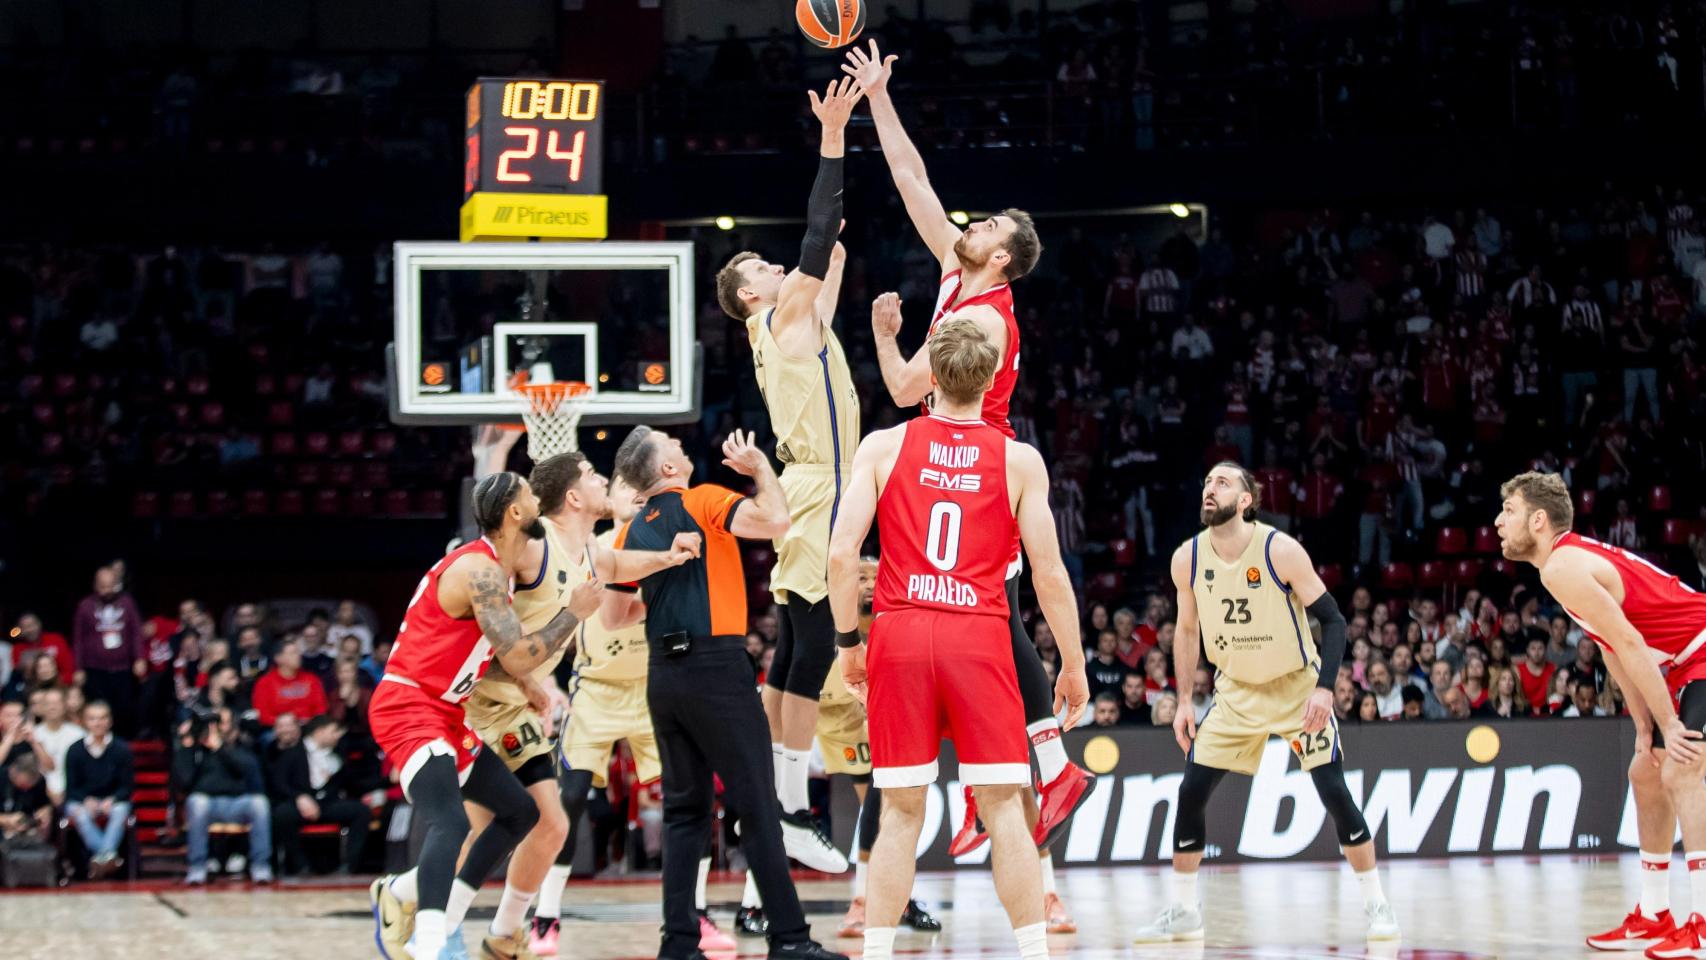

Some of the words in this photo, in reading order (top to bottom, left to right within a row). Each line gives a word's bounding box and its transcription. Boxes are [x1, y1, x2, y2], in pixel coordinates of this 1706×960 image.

[502, 81, 599, 121] 10:00
[496, 127, 585, 182] 24
[517, 206, 590, 226] Piraeus
[929, 441, 980, 468] WALKUP
[920, 468, 981, 491] FMS
[926, 501, 963, 572] 0
[908, 574, 977, 607] PIRAEUS
[1221, 598, 1252, 624] 23
[519, 721, 542, 745] 4
[1032, 729, 1058, 746] GSA
[1299, 727, 1331, 757] 23
[1238, 726, 1582, 858] bwin
